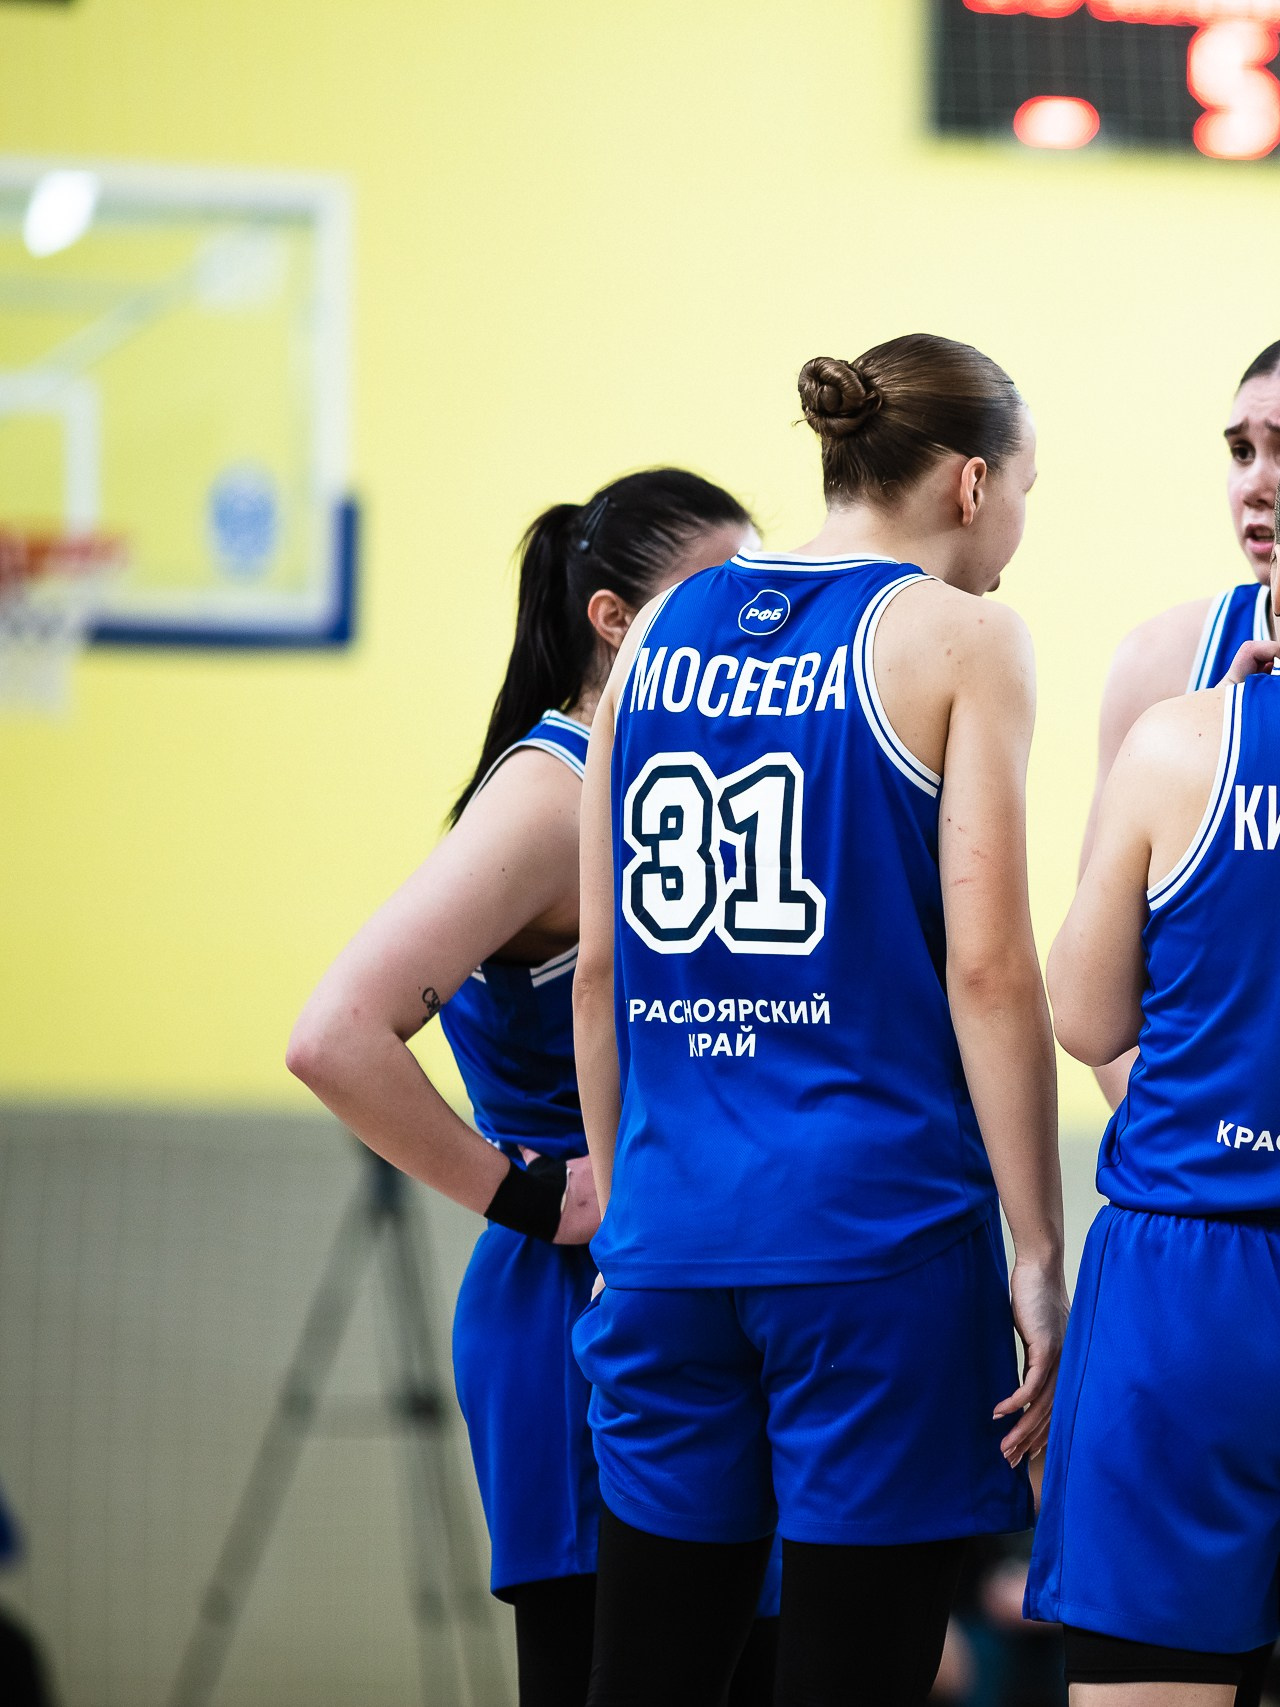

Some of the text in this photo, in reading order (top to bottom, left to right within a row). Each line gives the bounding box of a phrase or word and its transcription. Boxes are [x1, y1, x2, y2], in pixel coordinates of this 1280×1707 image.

[745, 607, 784, 622] РФБ
[629, 644, 849, 718] МОСЕЕВА
[621, 750, 827, 956] 31
[626, 992, 831, 1025] РАСНОЯРСКИЙ
[688, 1024, 757, 1058] КРАЙ
